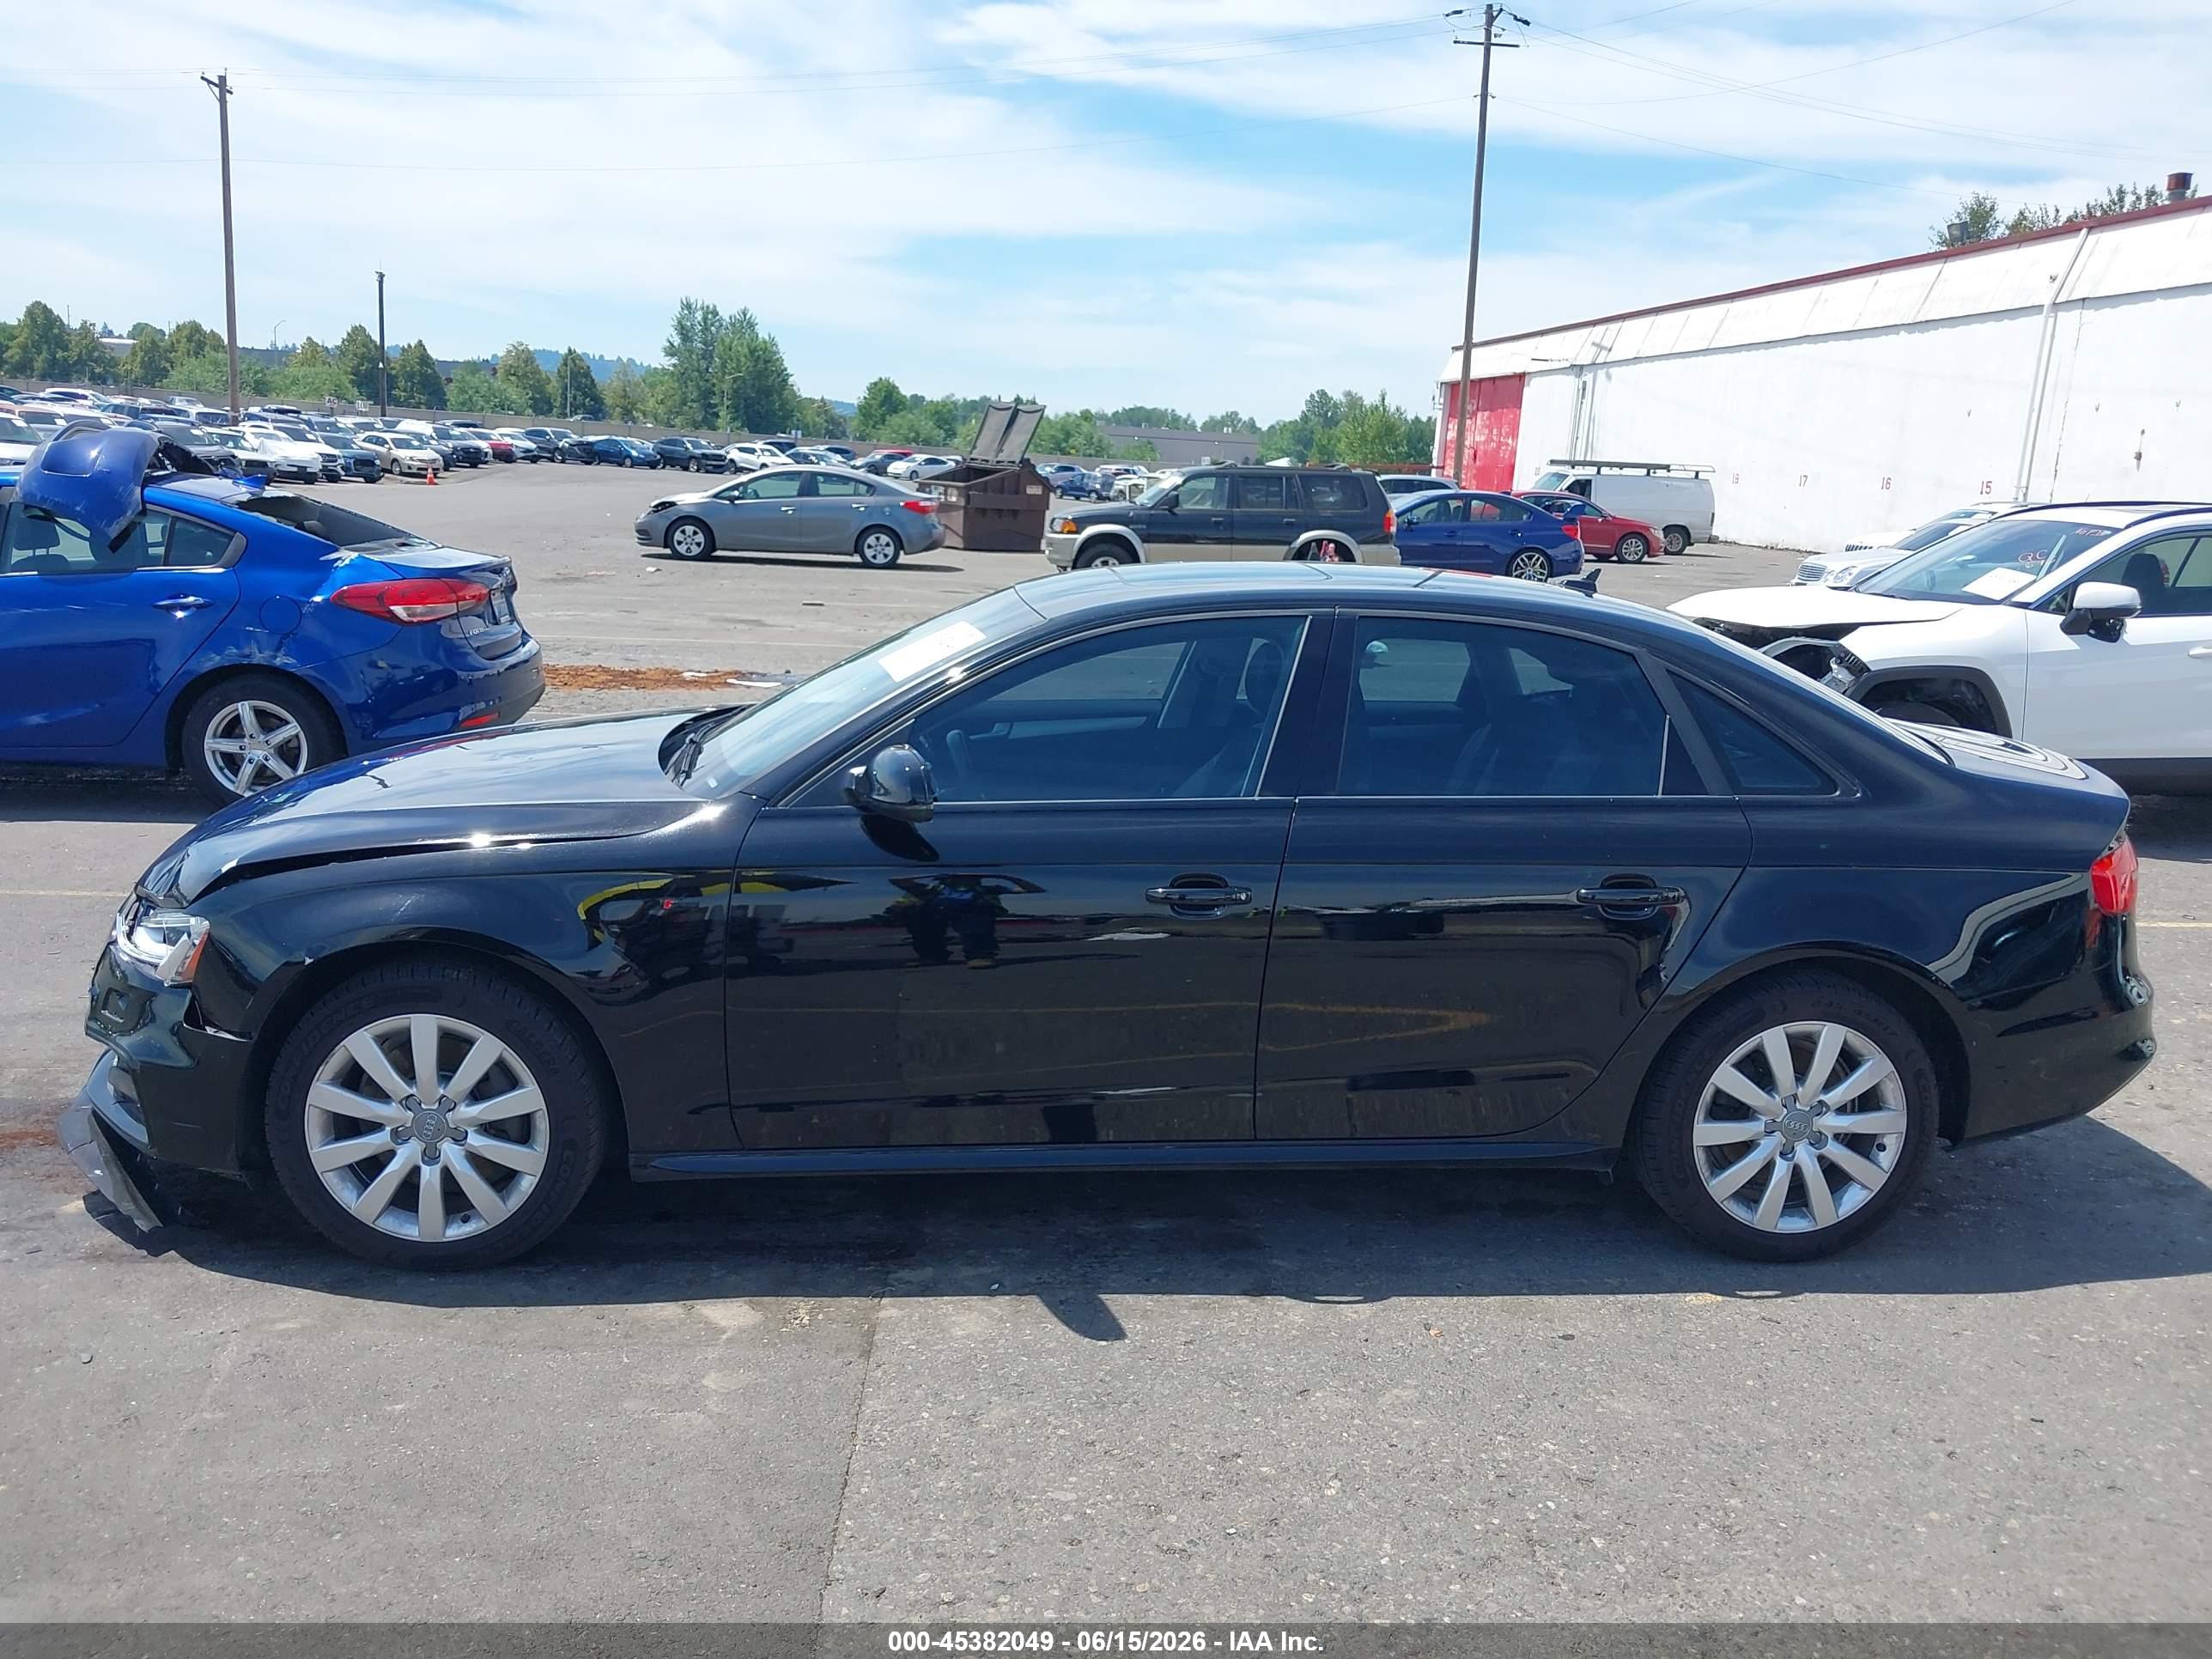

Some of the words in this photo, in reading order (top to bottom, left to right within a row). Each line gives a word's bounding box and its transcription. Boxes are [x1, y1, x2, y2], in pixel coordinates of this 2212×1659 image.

[1798, 473, 1808, 487] 17
[1881, 476, 1892, 490] 16
[1979, 480, 1993, 495] 15
